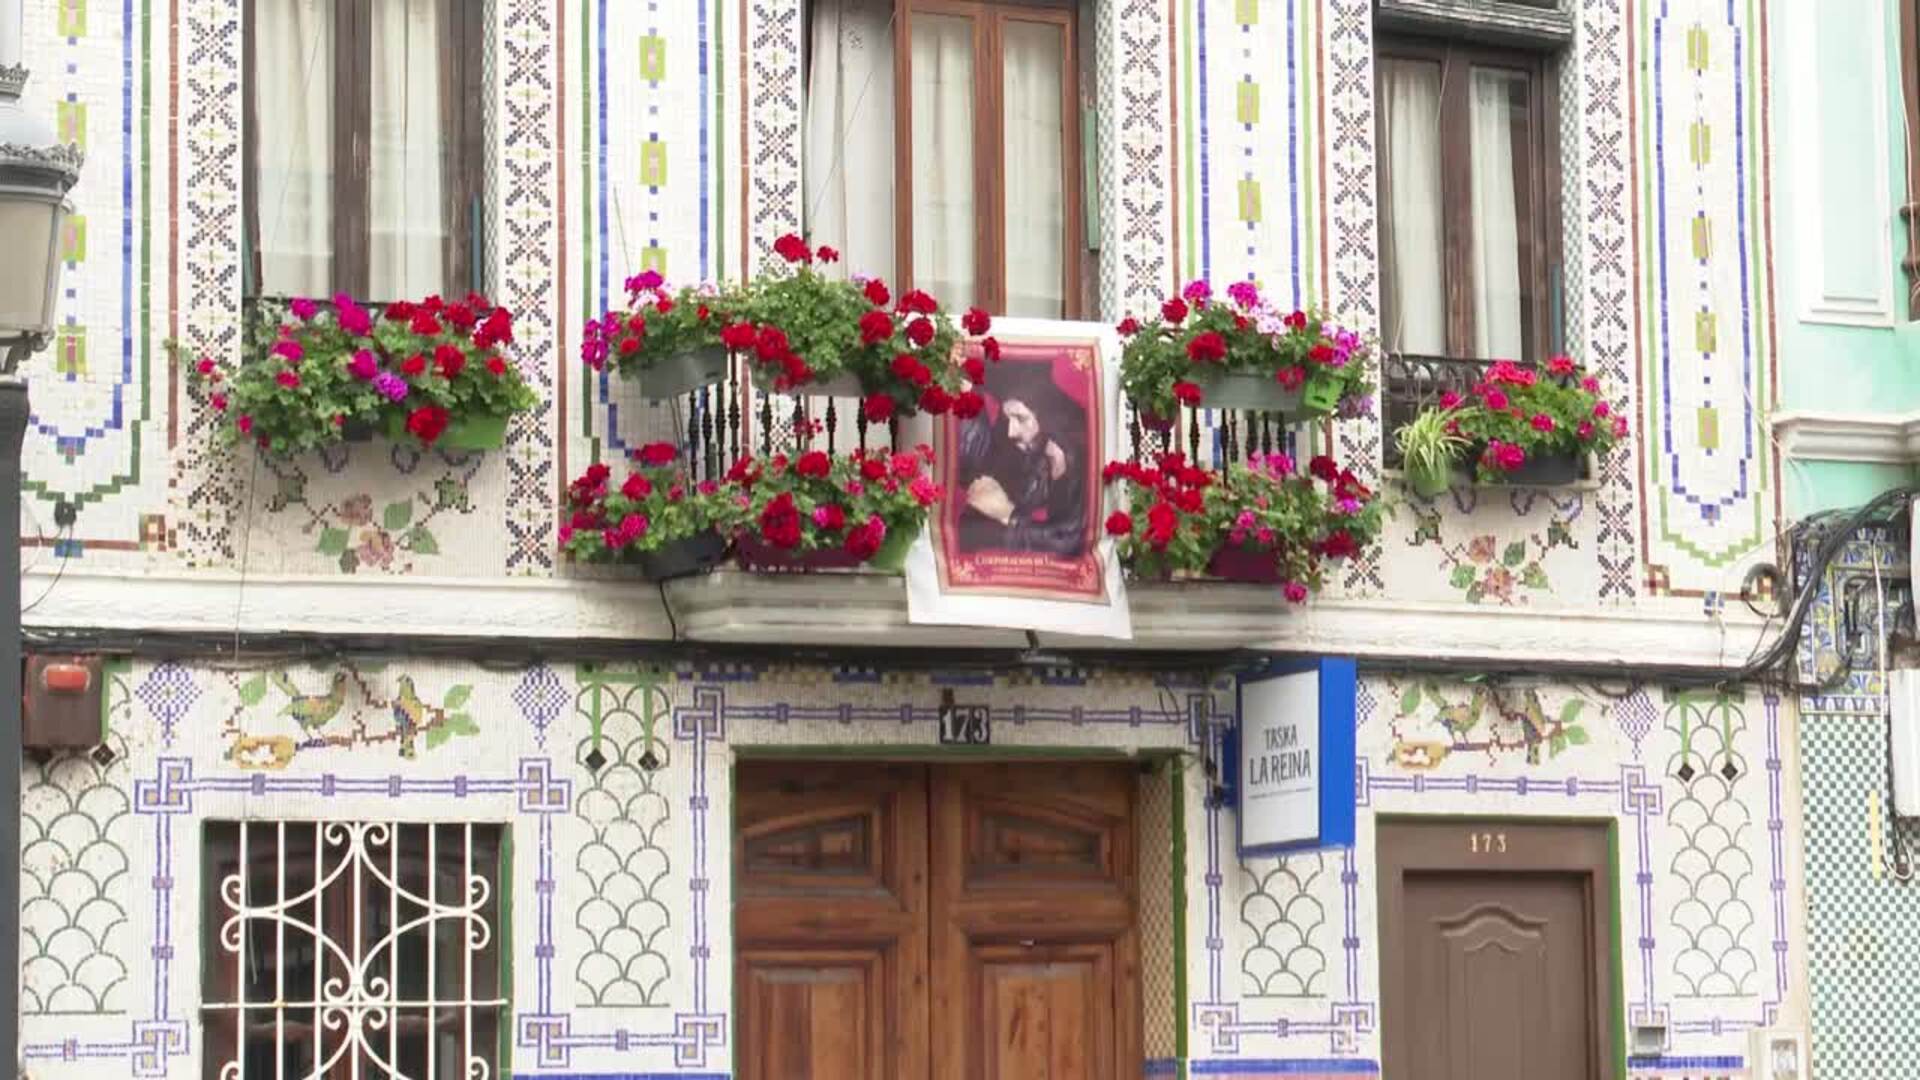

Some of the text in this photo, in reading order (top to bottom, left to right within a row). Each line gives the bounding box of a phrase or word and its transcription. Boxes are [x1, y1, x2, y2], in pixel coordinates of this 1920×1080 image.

[942, 708, 988, 742] 173
[1264, 724, 1298, 751] TASKA
[1249, 749, 1312, 785] LA REINA
[1471, 833, 1507, 853] 173
